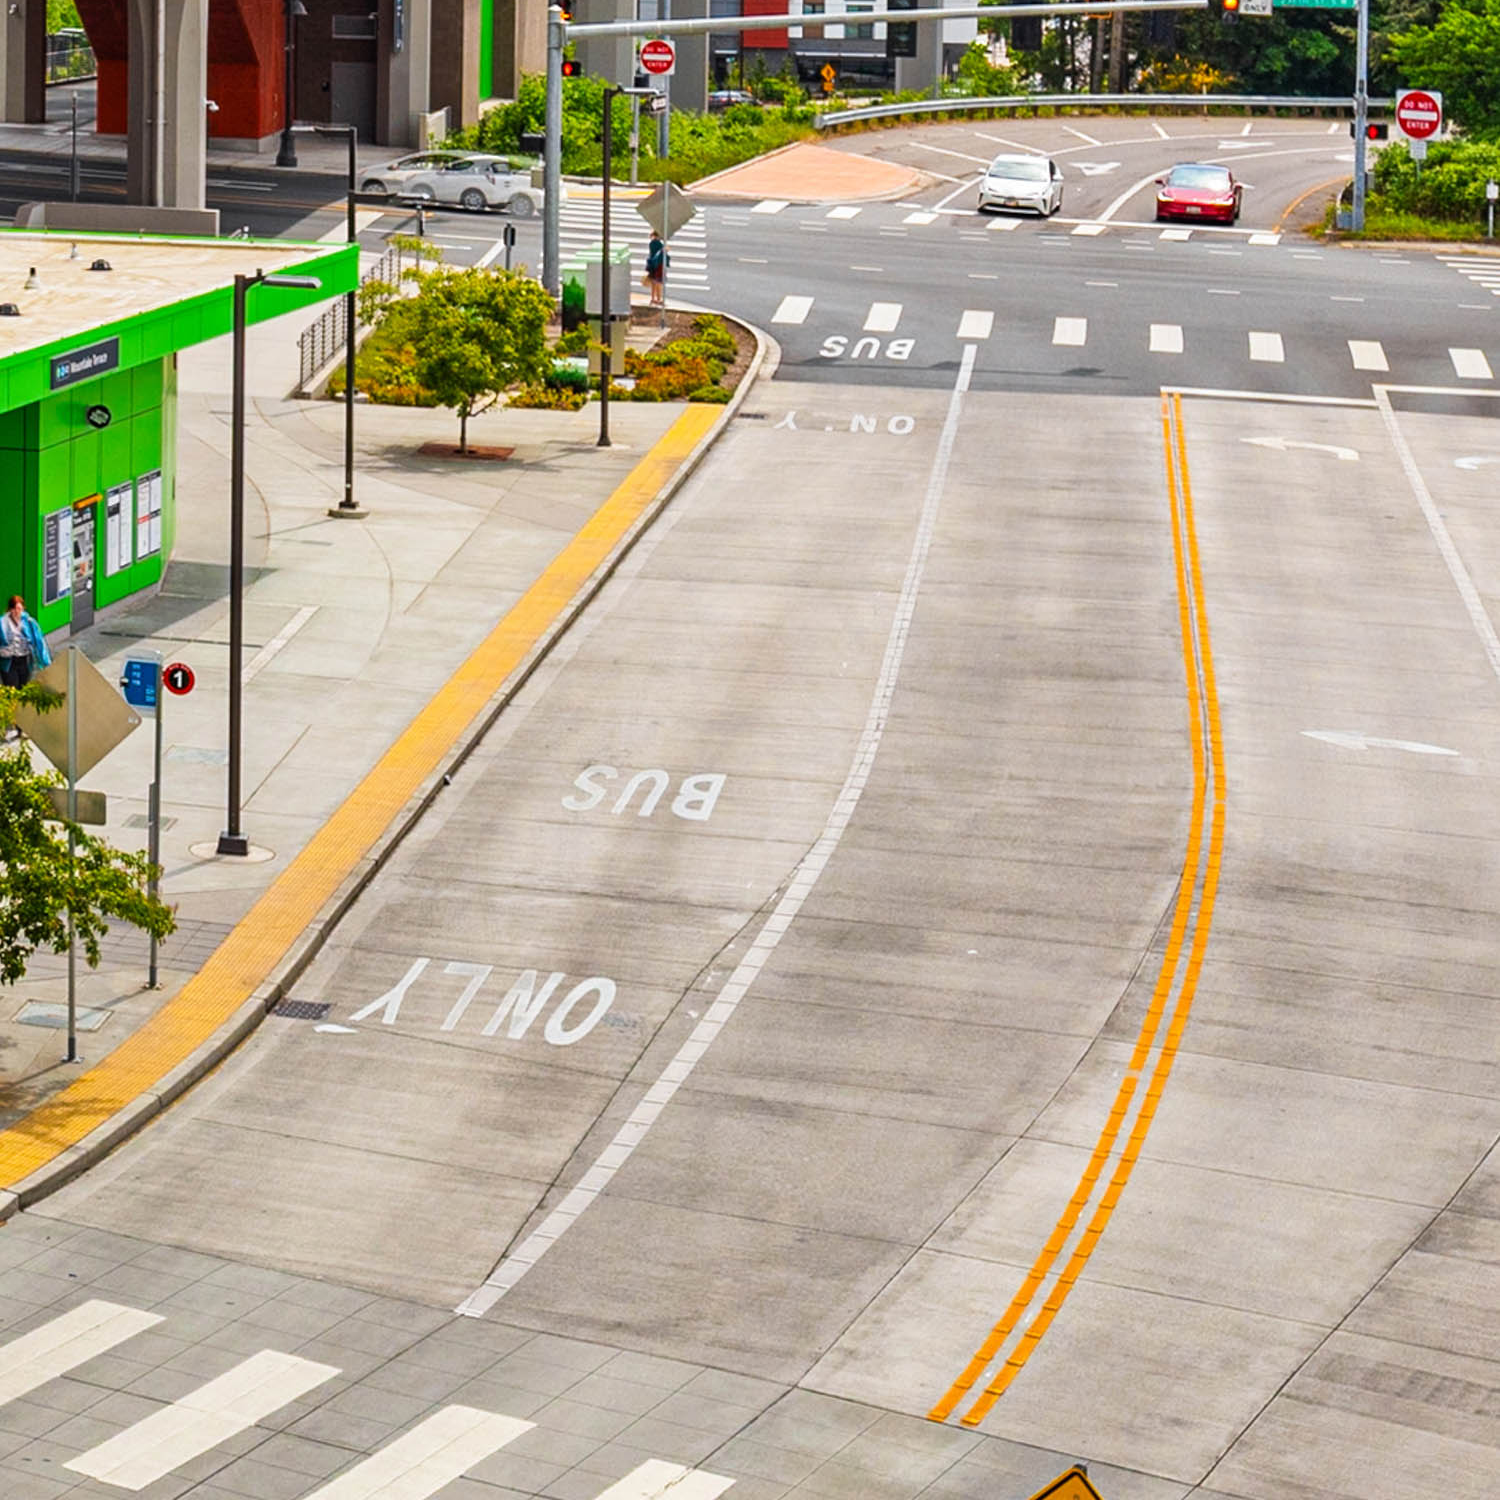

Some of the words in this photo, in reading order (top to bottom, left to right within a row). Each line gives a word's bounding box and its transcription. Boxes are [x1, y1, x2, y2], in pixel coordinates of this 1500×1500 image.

[1244, 4, 1267, 13] ONLY
[1404, 100, 1414, 109] DO
[1417, 101, 1433, 110] NOT
[1406, 121, 1430, 130] ENTER
[820, 335, 916, 361] BUS
[774, 411, 915, 436] ONY
[173, 670, 183, 688] 1
[562, 765, 727, 821] BUS
[348, 957, 617, 1046] ONLY
